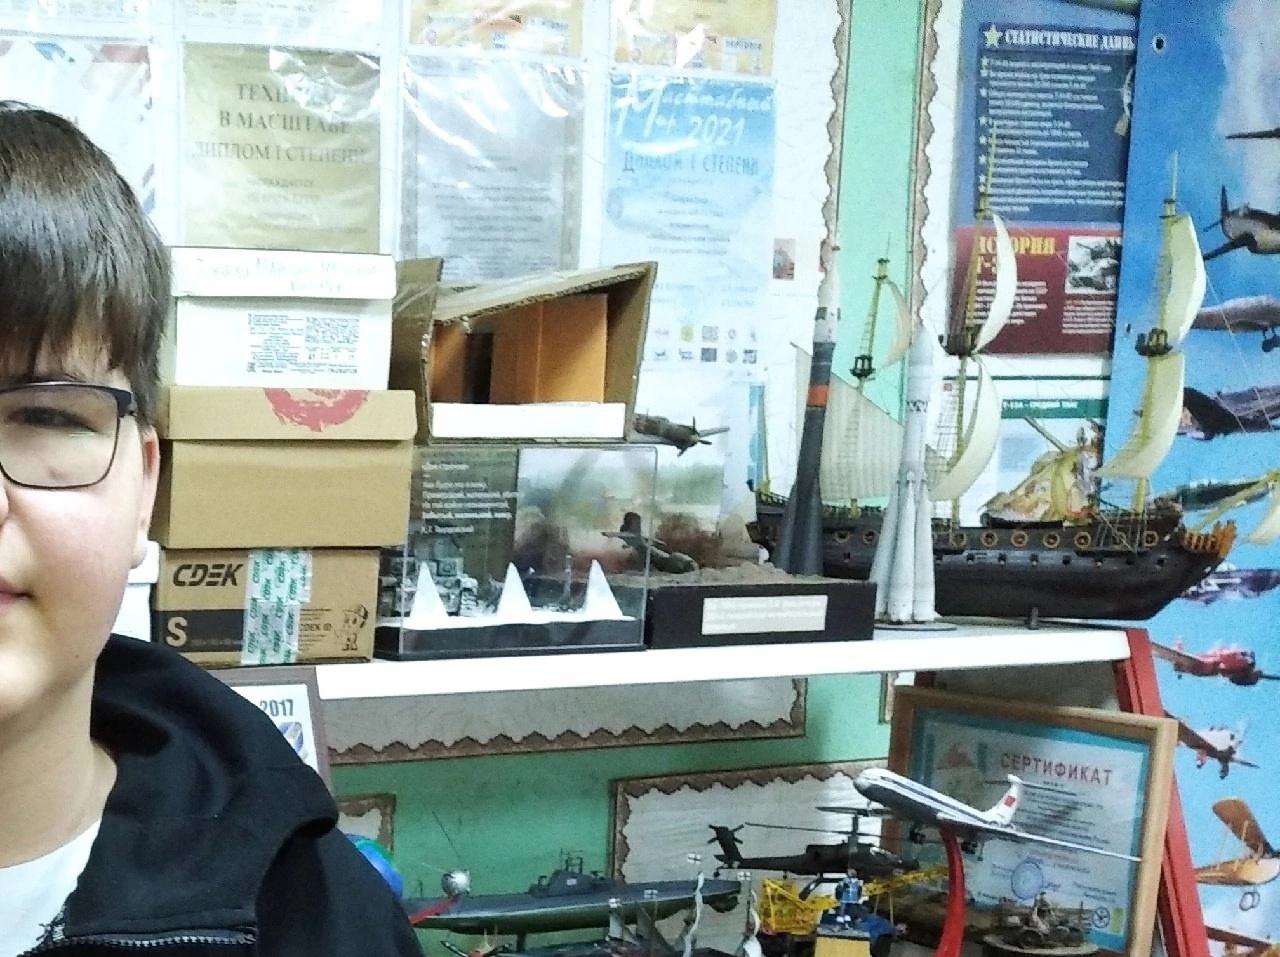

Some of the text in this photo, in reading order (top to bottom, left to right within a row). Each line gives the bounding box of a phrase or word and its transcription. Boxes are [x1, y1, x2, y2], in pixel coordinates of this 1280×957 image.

[173, 563, 244, 589] CDEK
[166, 616, 189, 647] S
[260, 698, 294, 719] 2017
[1000, 753, 1112, 786] СЕРТИФИКАТ
